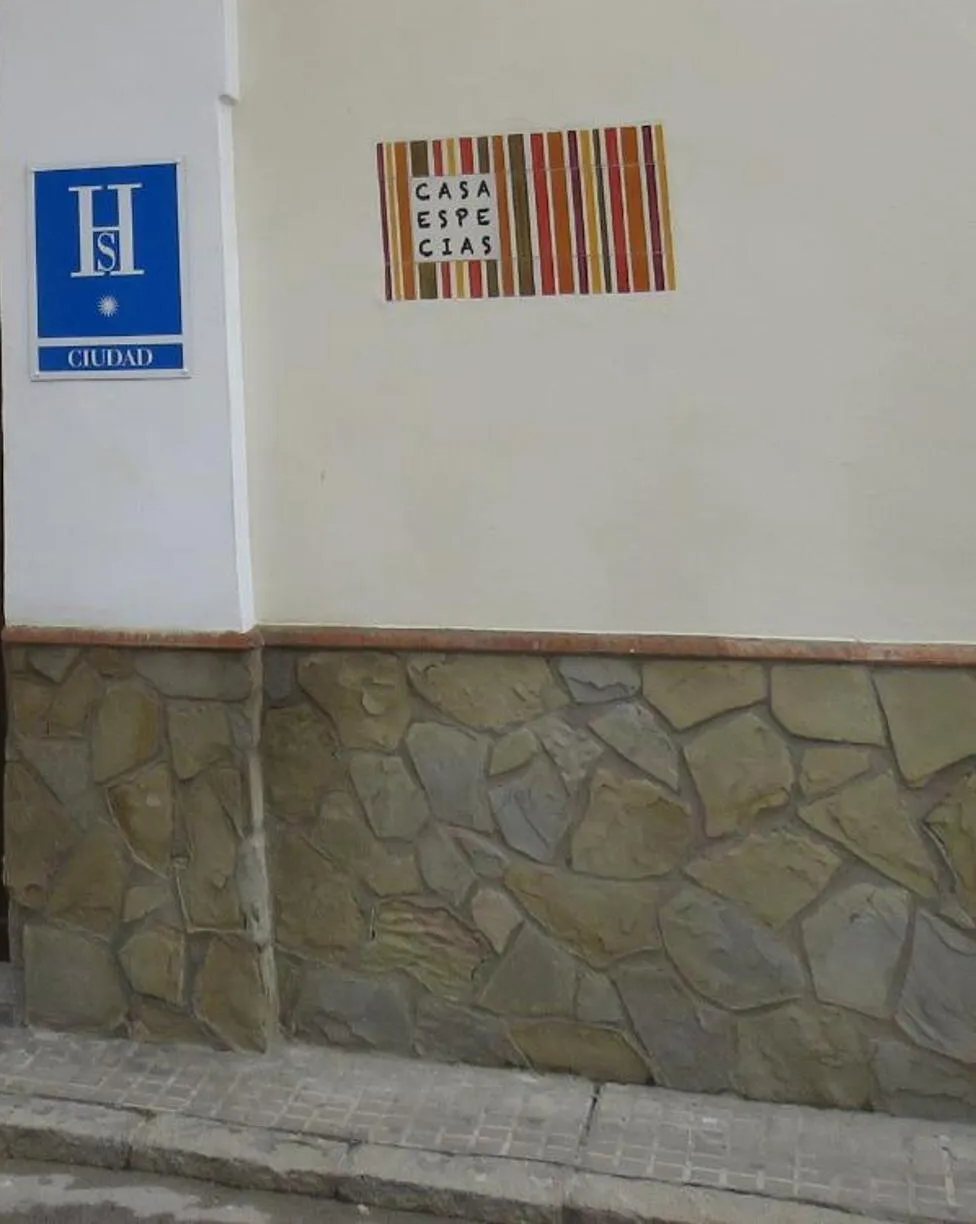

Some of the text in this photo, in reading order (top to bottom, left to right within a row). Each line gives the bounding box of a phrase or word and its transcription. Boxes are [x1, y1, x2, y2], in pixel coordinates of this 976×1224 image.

[415, 179, 491, 201] CASA
[417, 207, 491, 229] ESPE
[418, 236, 493, 257] CIAS
[67, 348, 154, 368] CIUDAD
